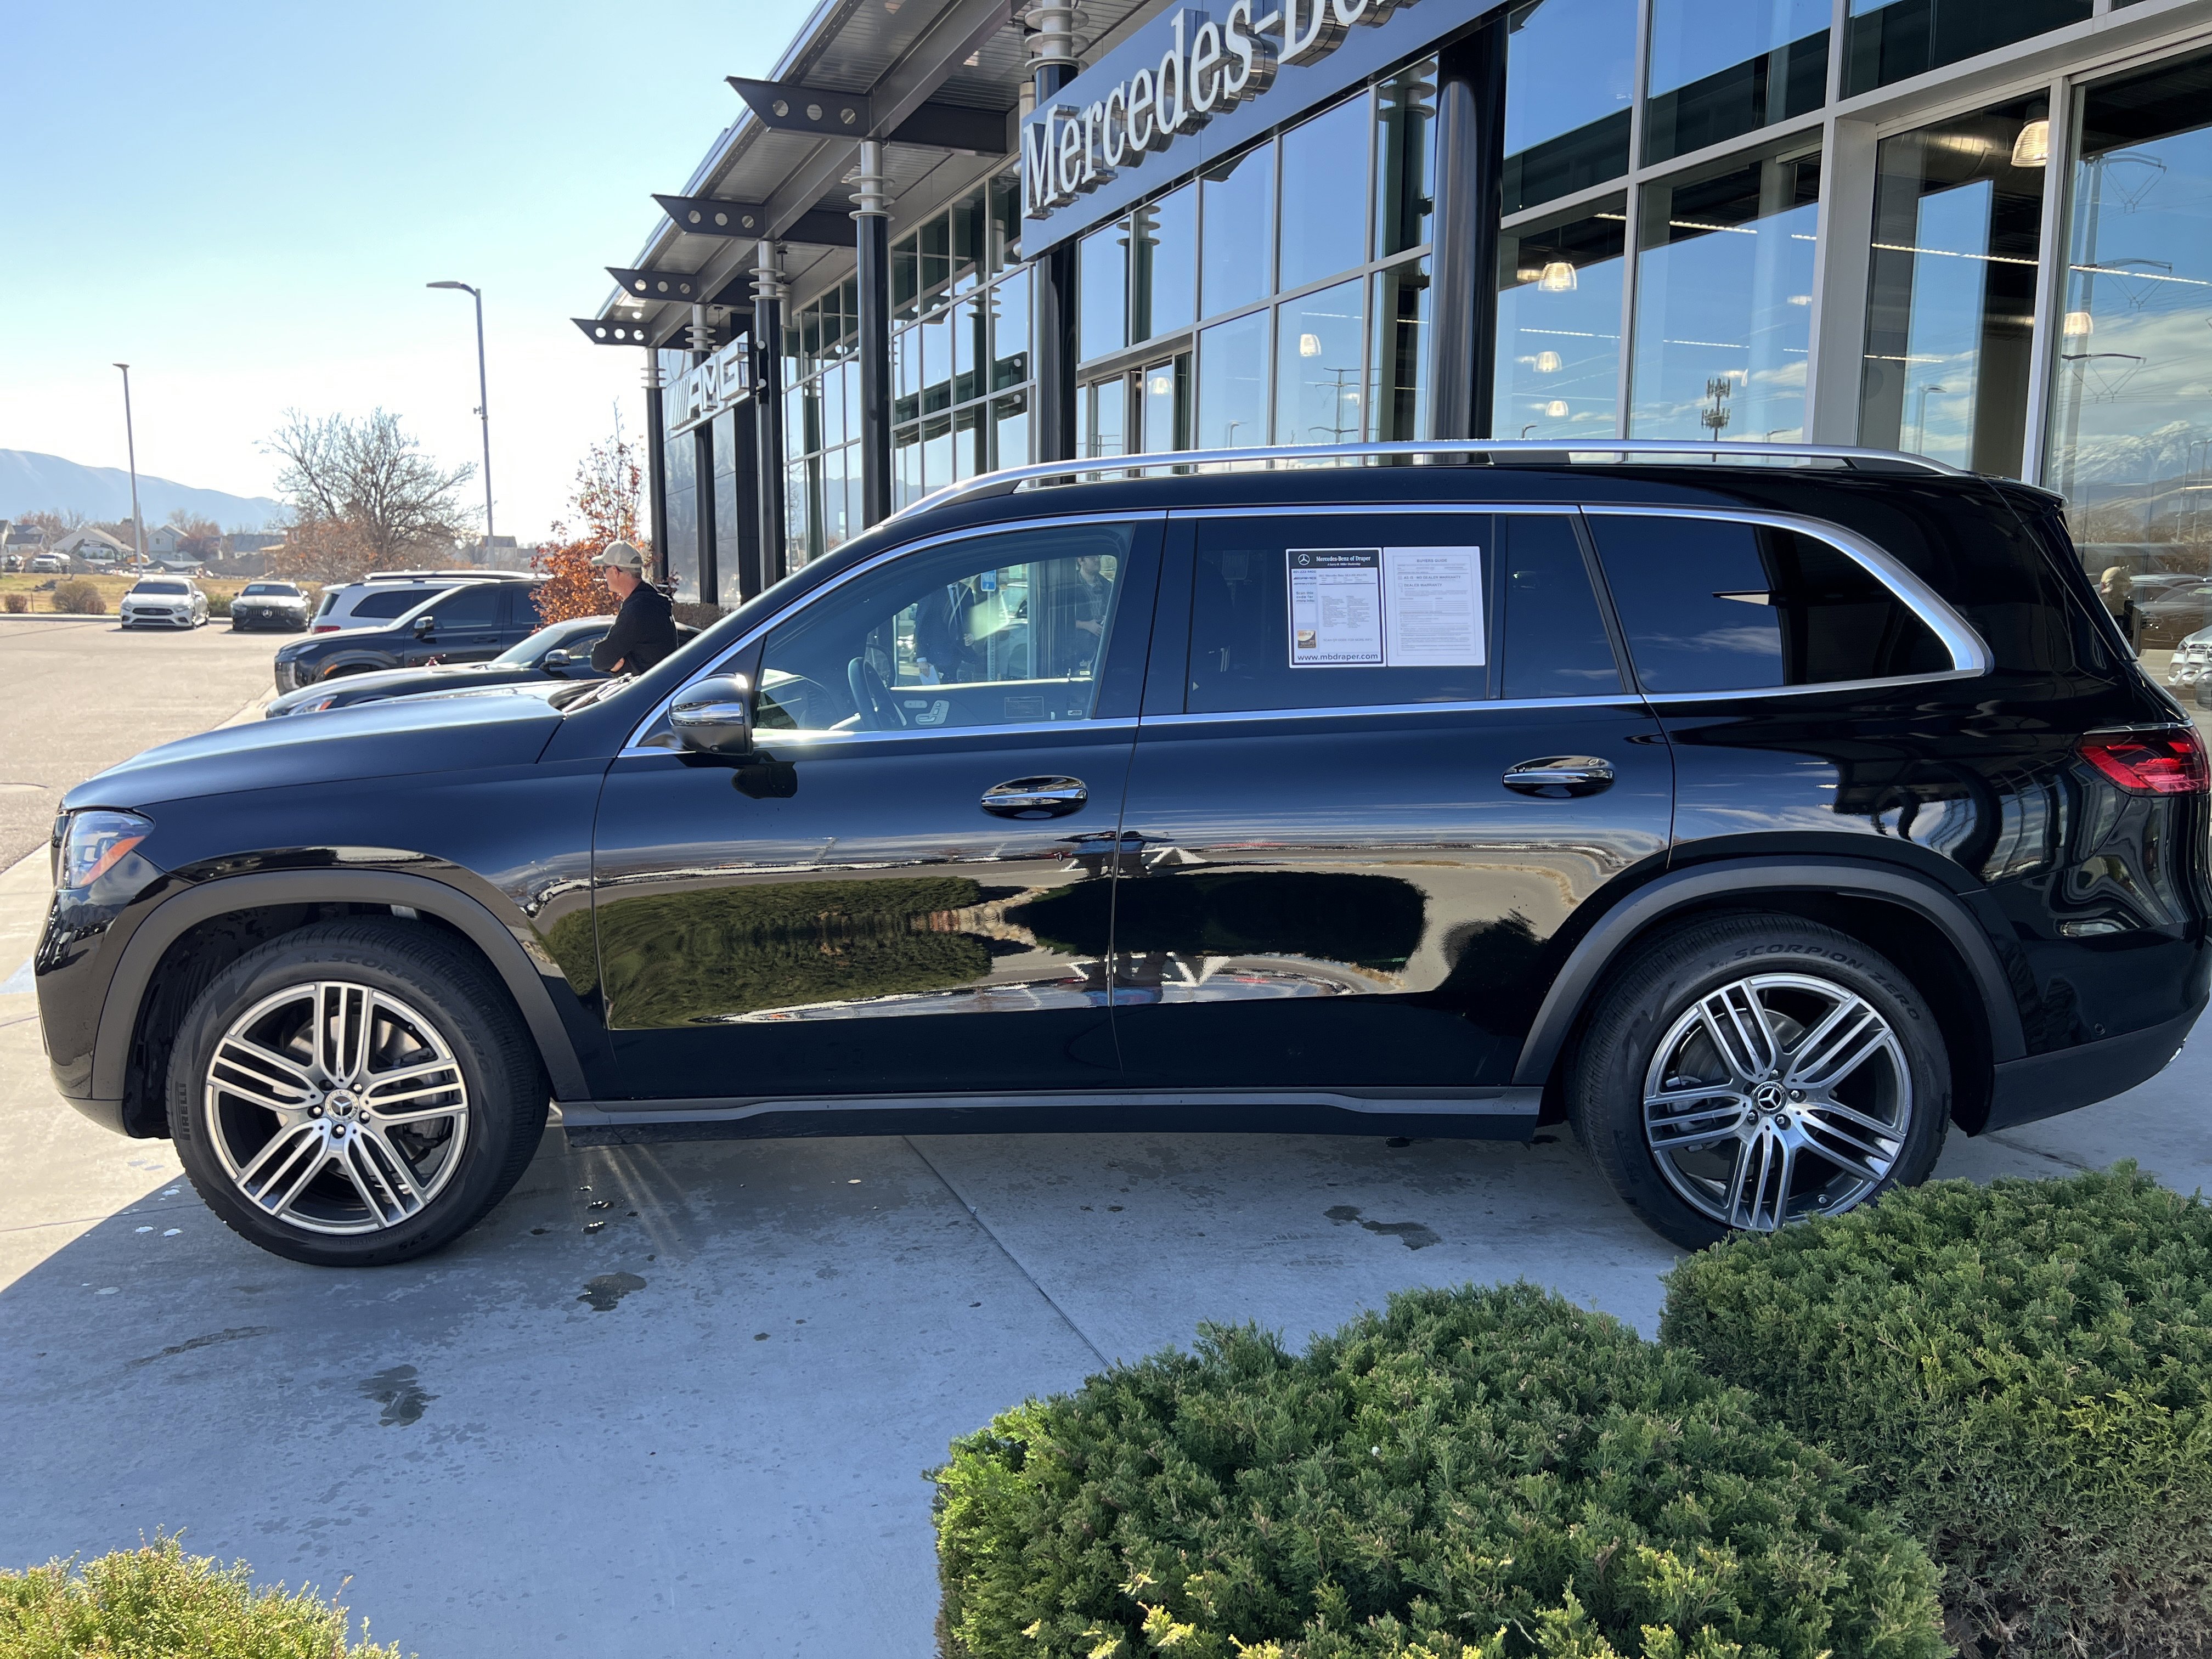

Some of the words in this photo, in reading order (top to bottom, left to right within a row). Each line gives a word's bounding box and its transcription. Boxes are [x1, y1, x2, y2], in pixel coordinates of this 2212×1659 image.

[1023, 0, 1386, 219] Mercedes-
[685, 341, 748, 418] AMG
[1734, 944, 1863, 969] SCORPION
[1867, 972, 1921, 1020] ZERO
[176, 1081, 191, 1141] PIRELLI
